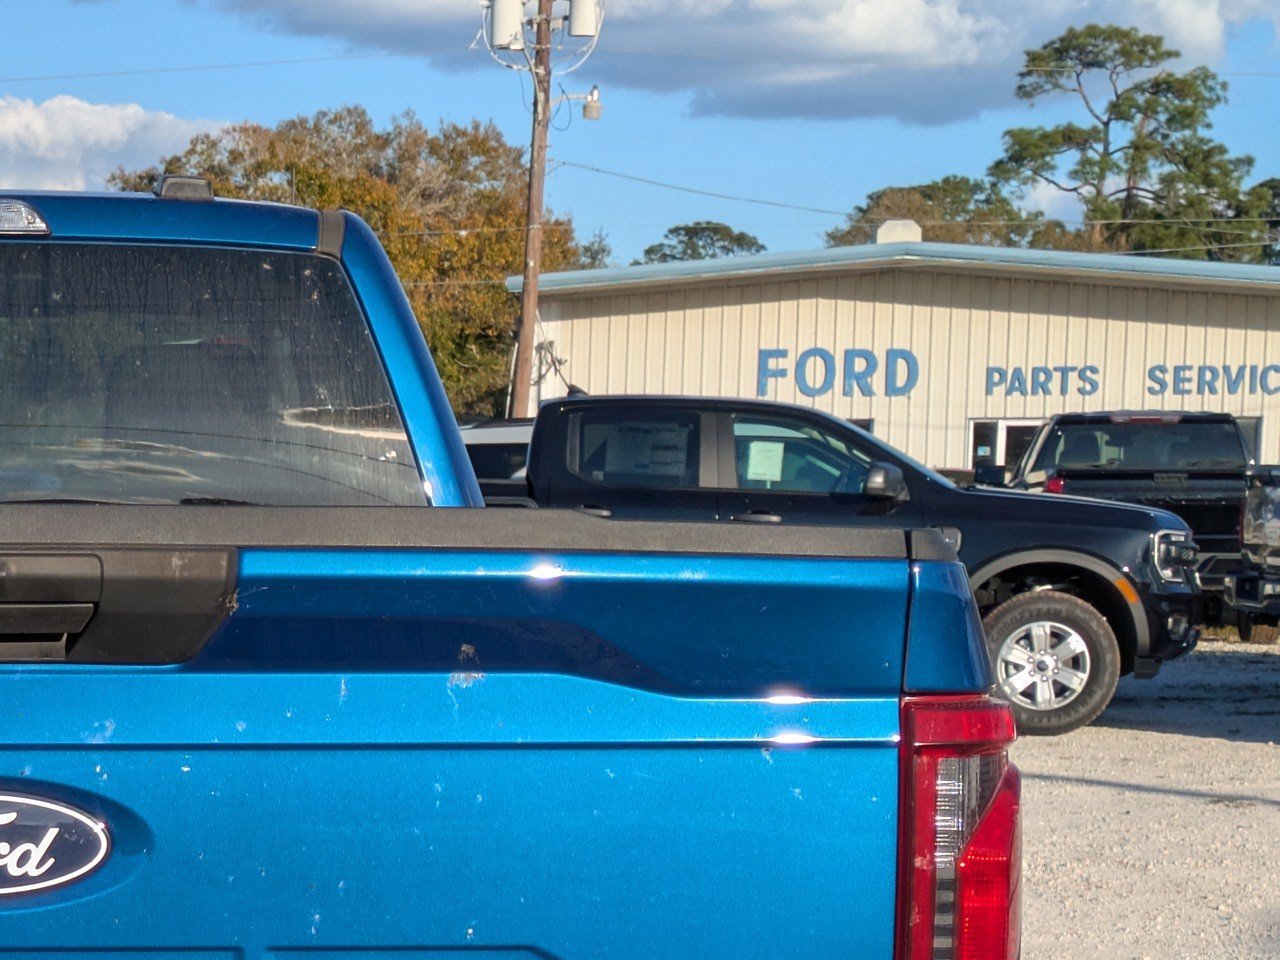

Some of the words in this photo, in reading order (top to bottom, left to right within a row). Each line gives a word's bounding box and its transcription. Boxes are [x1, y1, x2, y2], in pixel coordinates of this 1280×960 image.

[757, 347, 919, 398] FORD
[985, 365, 1100, 396] PARTS
[1147, 364, 1280, 396] SERVIC
